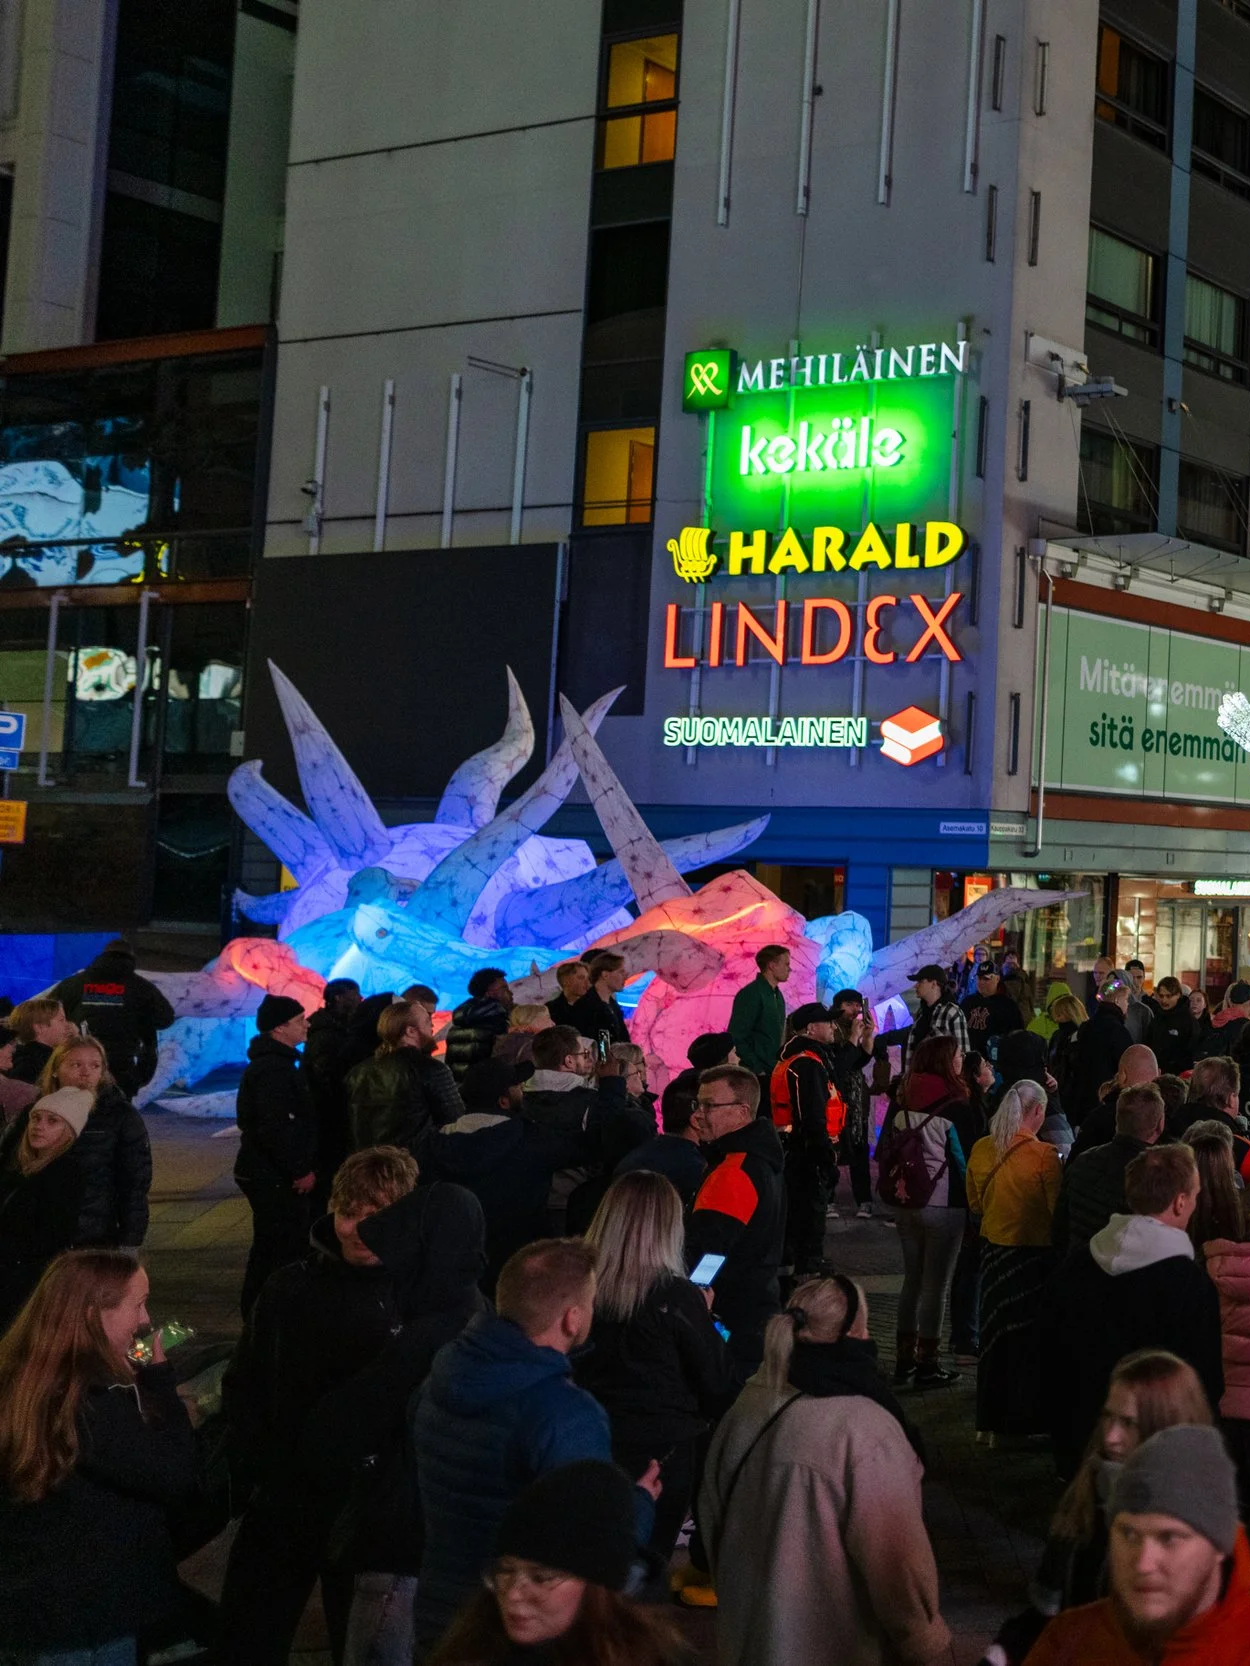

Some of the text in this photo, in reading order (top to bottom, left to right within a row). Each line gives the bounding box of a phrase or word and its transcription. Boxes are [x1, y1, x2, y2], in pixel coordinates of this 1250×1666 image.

[739, 340, 967, 393] MEHILÄINEN
[739, 416, 906, 476] kekäle
[728, 520, 966, 575] HARALD
[664, 592, 963, 668] LINDEX
[1079, 655, 1136, 699] Mitä
[663, 716, 867, 747] SUOMALAINEN
[1089, 712, 1135, 751] sitä
